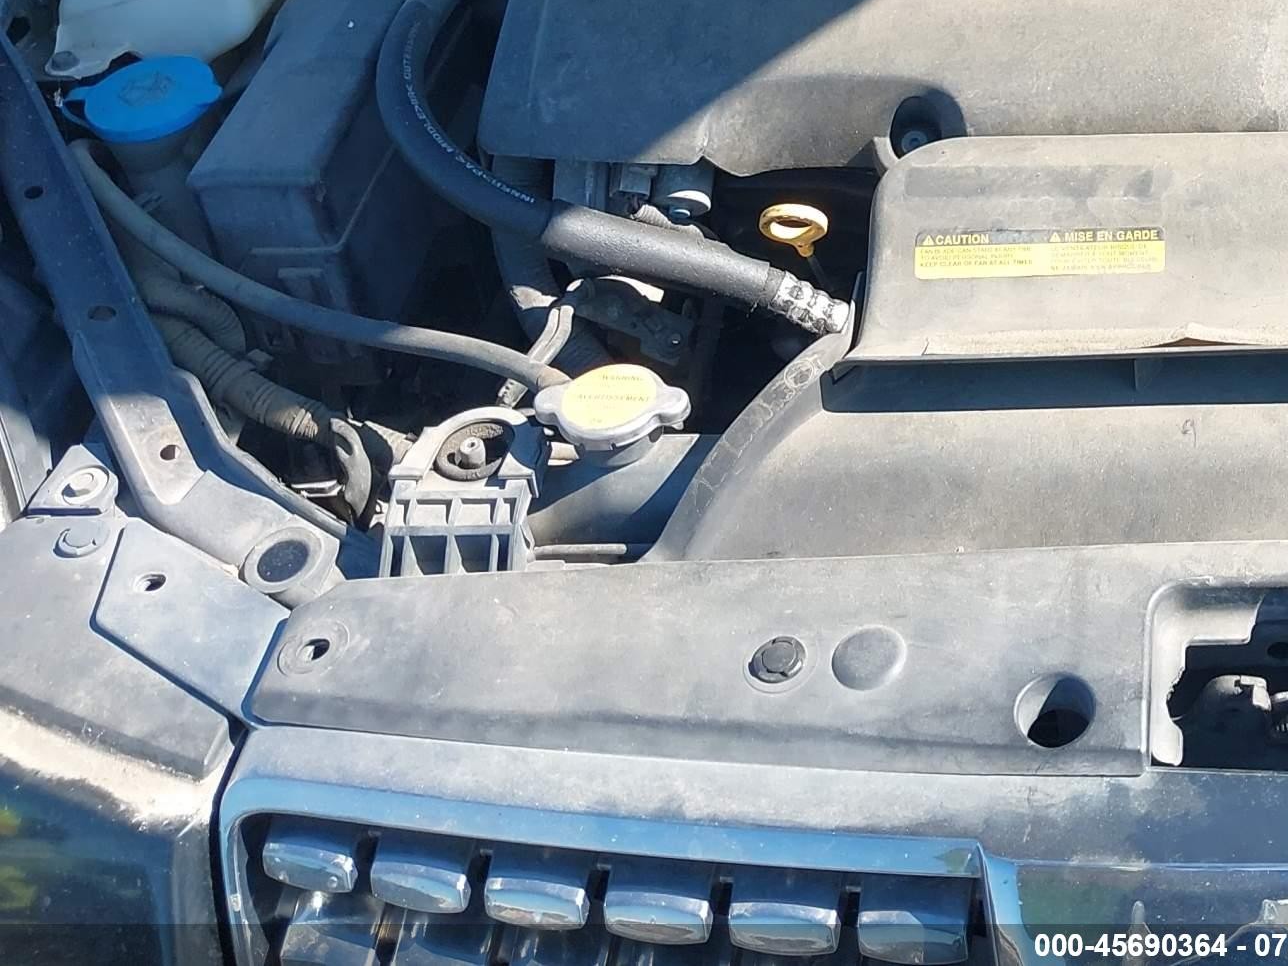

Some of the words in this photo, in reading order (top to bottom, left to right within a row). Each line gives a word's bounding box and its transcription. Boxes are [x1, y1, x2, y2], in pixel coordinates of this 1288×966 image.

[936, 234, 990, 245] CAUTION
[1064, 231, 1094, 242] MISE
[1097, 230, 1113, 241] EN
[1116, 229, 1158, 241] GARDE
